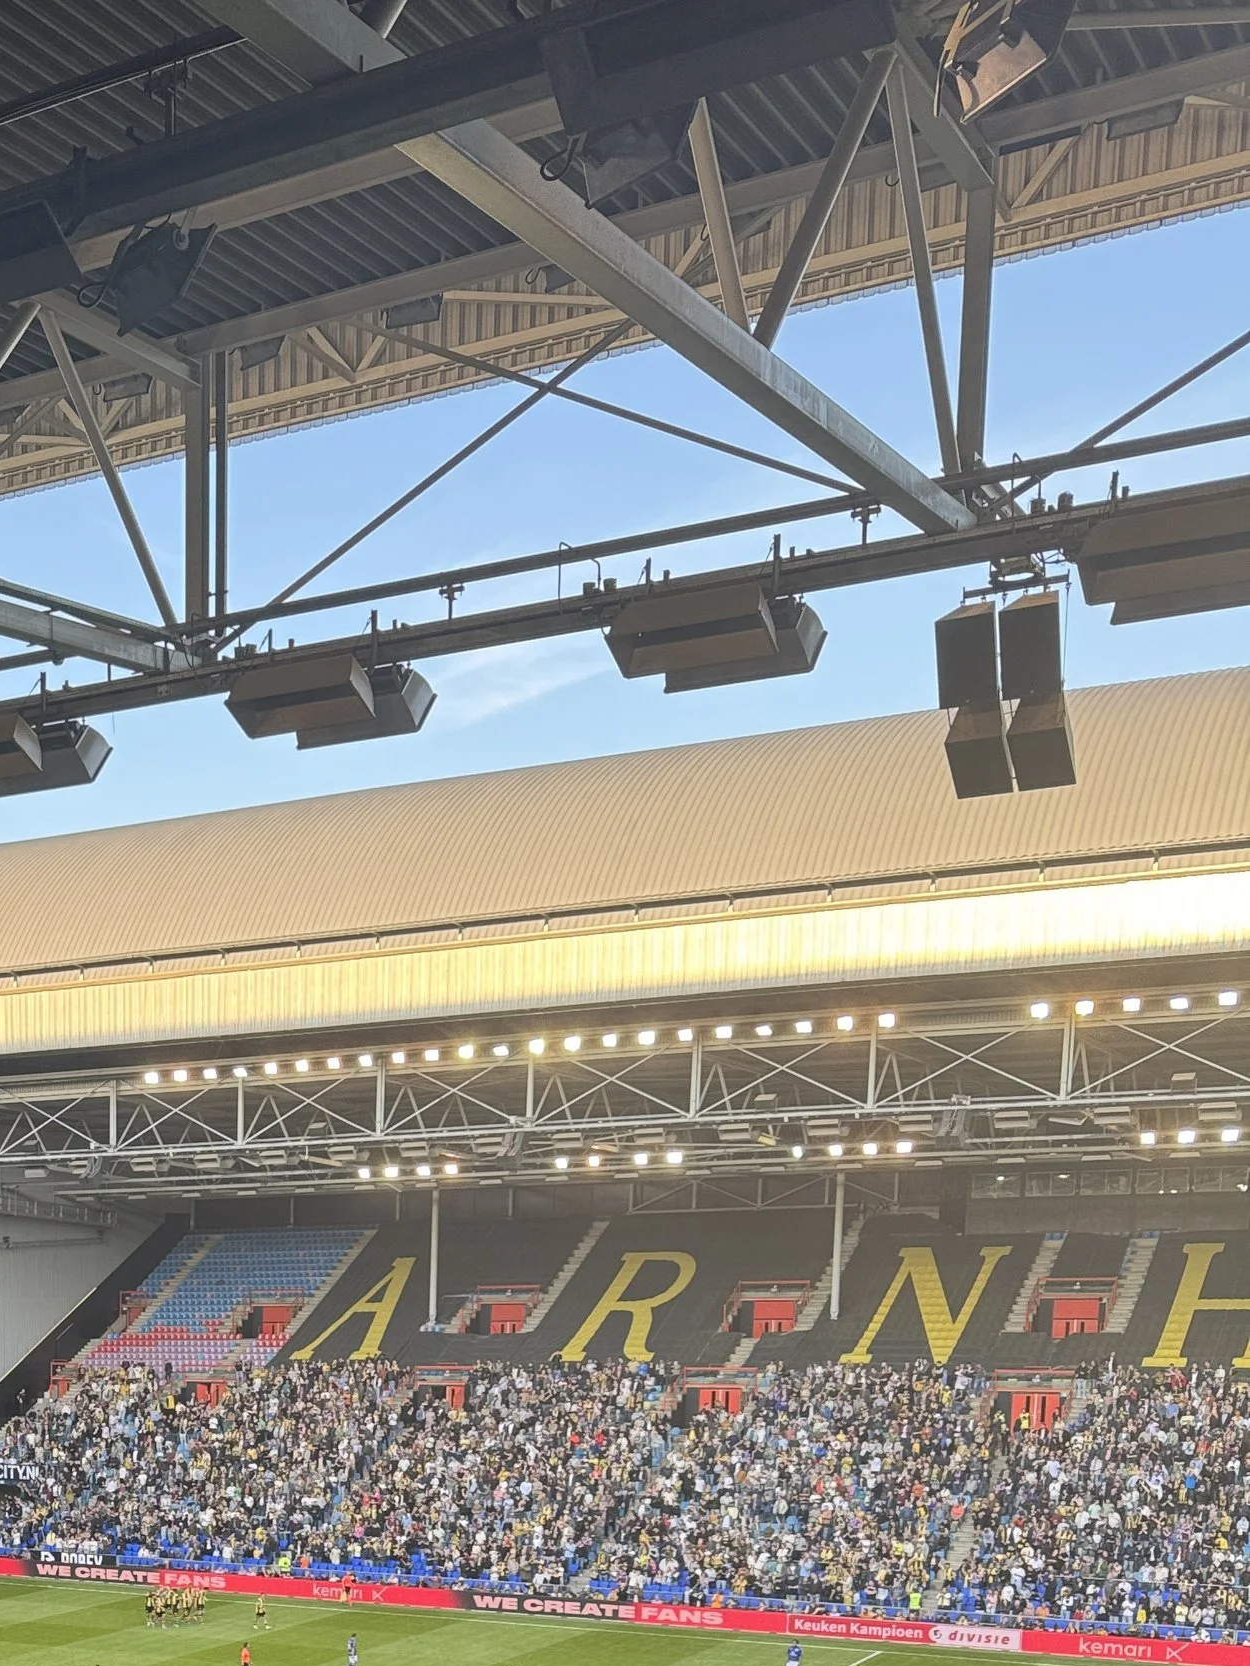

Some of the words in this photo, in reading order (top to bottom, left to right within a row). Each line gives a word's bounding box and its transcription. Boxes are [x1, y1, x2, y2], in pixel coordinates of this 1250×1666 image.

[36, 1564, 71, 1576] WE
[75, 1566, 160, 1583] CREATE
[164, 1571, 227, 1589] FANS
[473, 1595, 518, 1611] WE
[523, 1598, 636, 1619] CREATE
[640, 1607, 725, 1626] FANS
[794, 1618, 847, 1634] Keuken
[850, 1621, 923, 1640] Kampioen
[949, 1630, 1011, 1645] divisie
[1079, 1637, 1151, 1658] kemari
